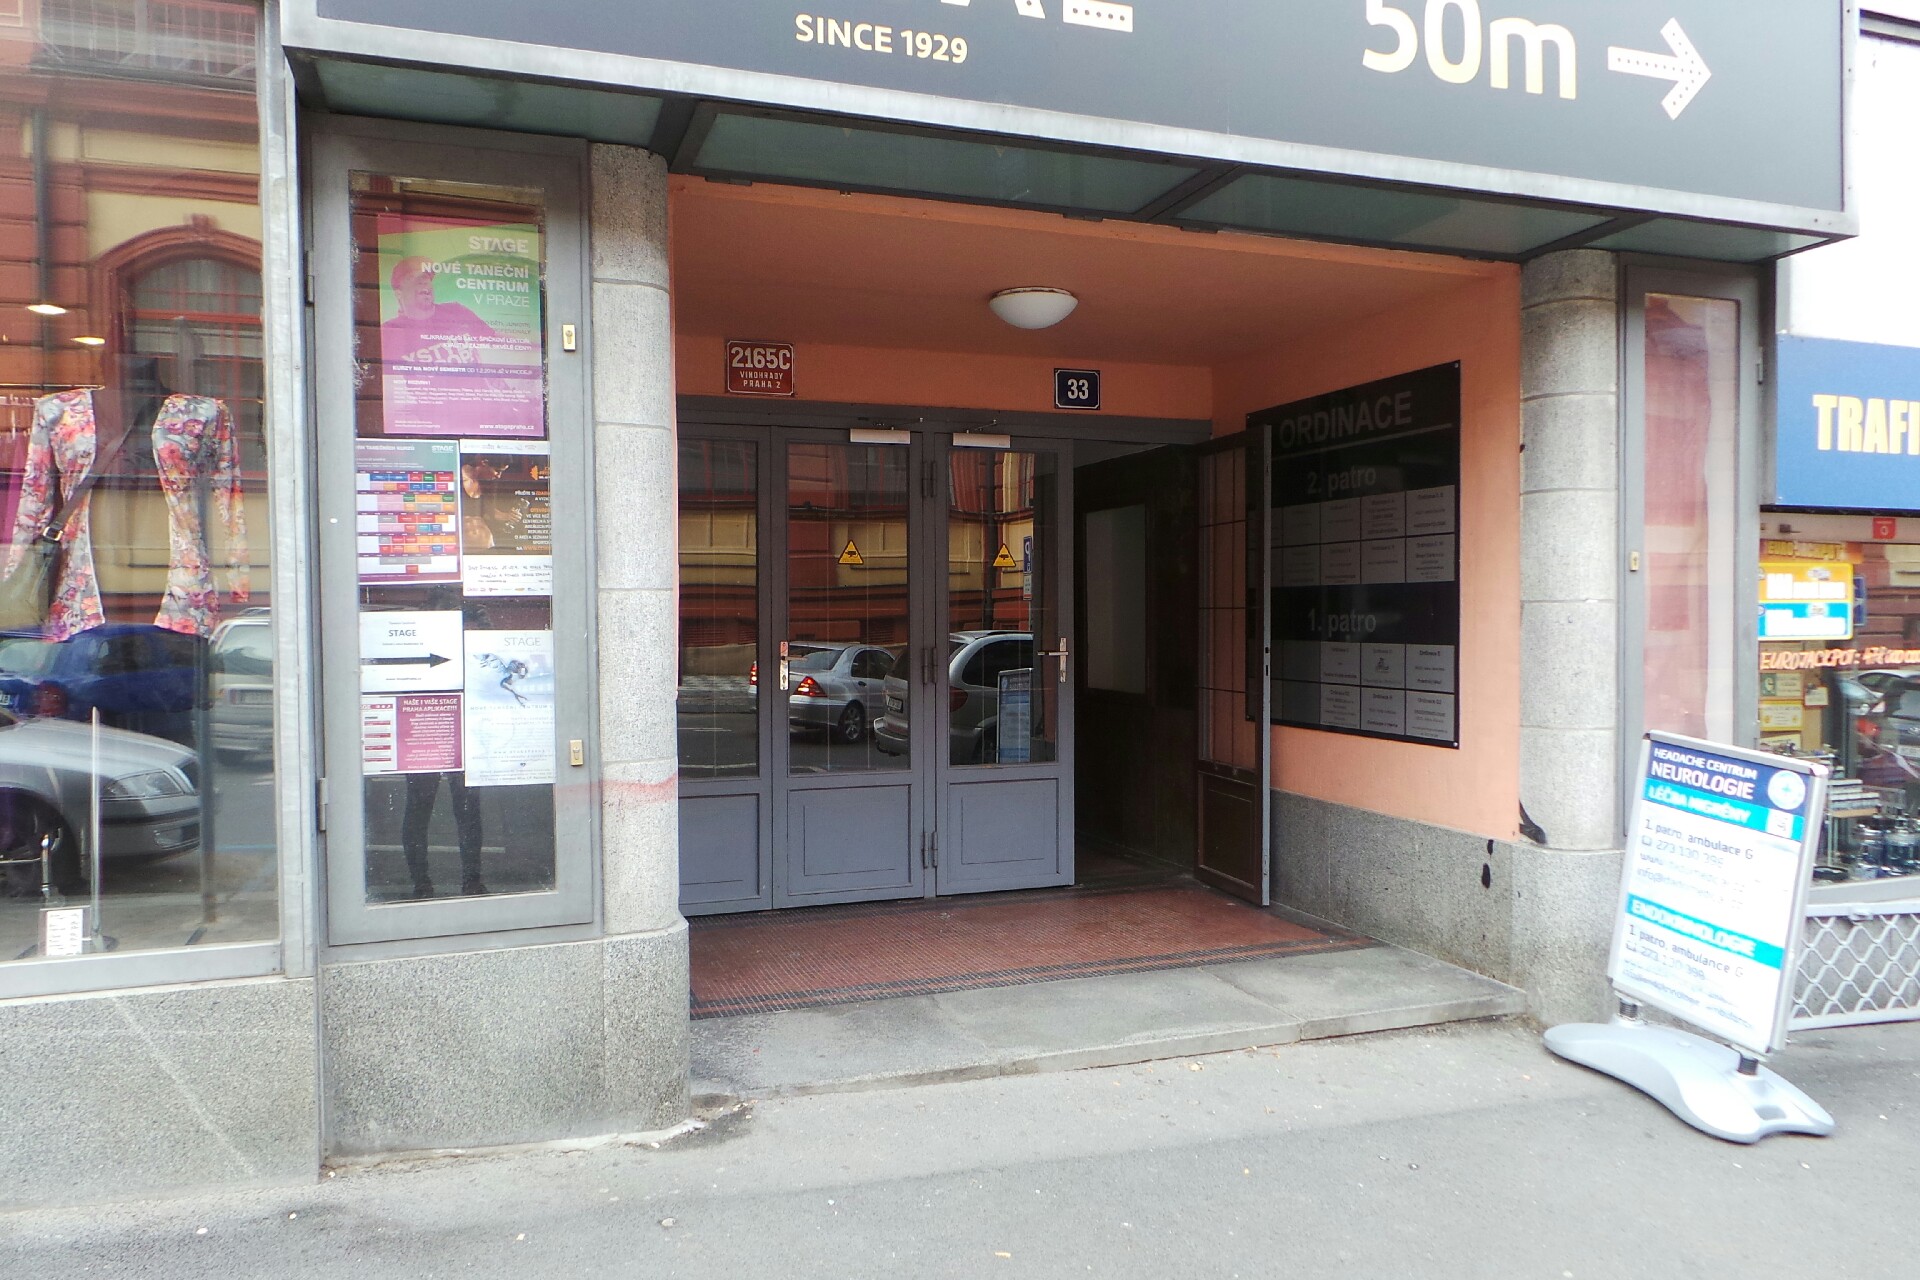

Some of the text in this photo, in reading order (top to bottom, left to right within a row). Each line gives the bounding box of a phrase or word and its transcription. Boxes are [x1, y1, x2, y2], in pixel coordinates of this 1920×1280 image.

[795, 13, 893, 54] SINCE
[900, 30, 968, 64] 1929
[1362, 0, 1576, 100] 50m
[469, 235, 529, 253] STAGE
[421, 261, 529, 279] NOVÉ TANEČNÍ
[456, 278, 529, 293] CENTRUM
[473, 293, 530, 308] V PRAZE
[731, 346, 791, 370] 2165C
[740, 370, 784, 380] VINOHRADY
[743, 379, 781, 389] PRAHA 2
[1067, 378, 1089, 400] 33
[1279, 390, 1413, 449] ORDINACE
[1812, 393, 1920, 456] TRAFI
[1307, 465, 1377, 498] 2. patro
[388, 629, 417, 637] STAGE
[1308, 607, 1377, 639] 1. patro
[504, 636, 542, 647] STAGE
[403, 698, 419, 706] NAŠE
[1653, 747, 1758, 780] HEADACHE CENTRUM
[1651, 760, 1755, 800] NEUROLOGIE
[1687, 832, 1741, 856] ambulace
[1744, 848, 1754, 860] G
[1672, 943, 1730, 974] ambulance
